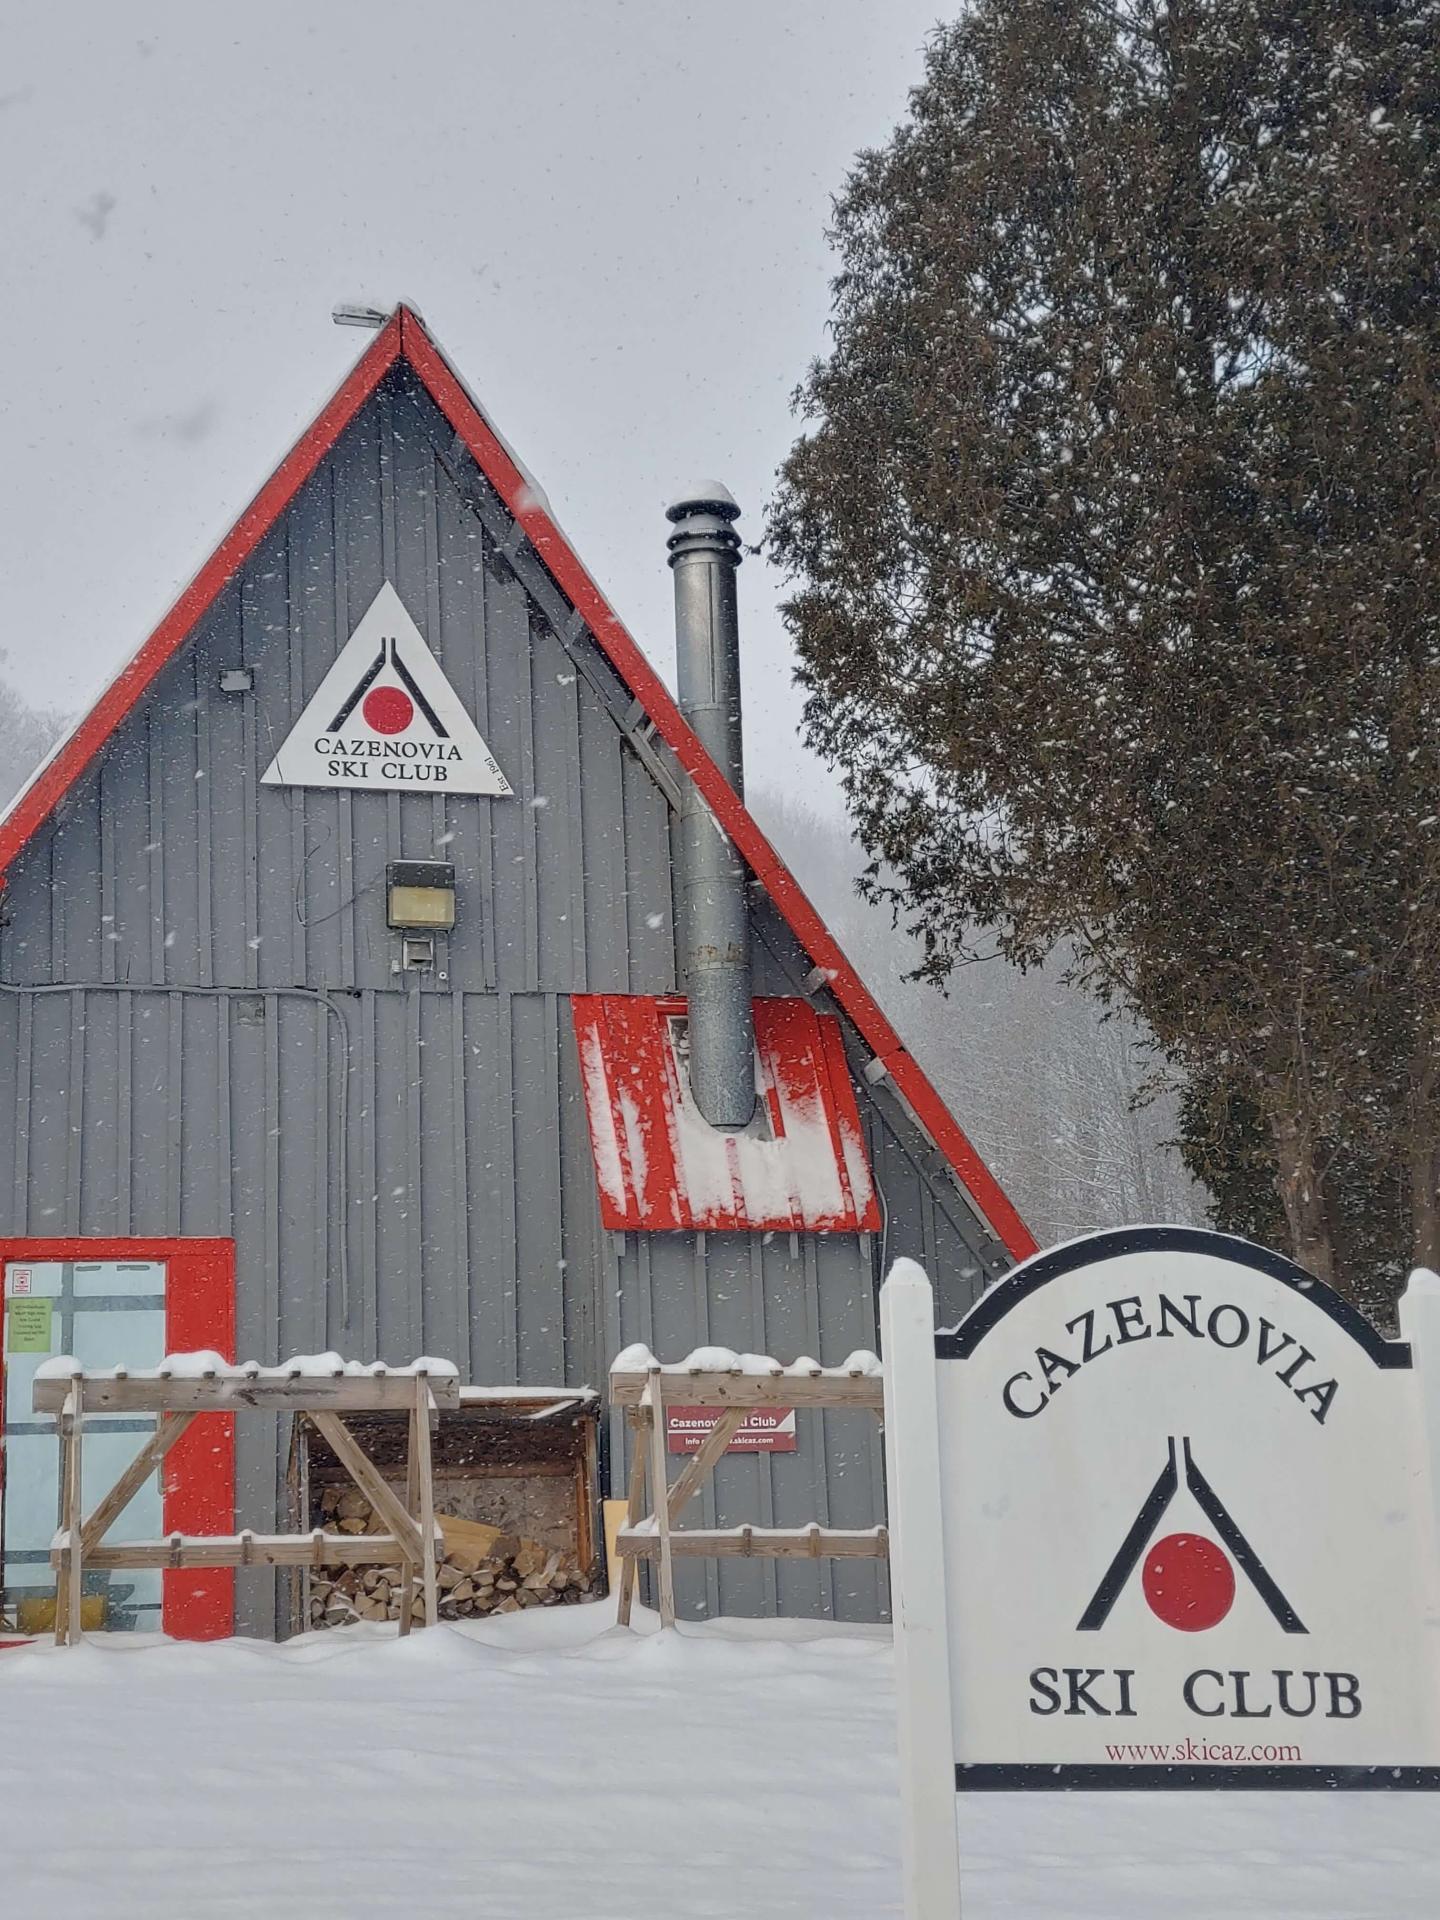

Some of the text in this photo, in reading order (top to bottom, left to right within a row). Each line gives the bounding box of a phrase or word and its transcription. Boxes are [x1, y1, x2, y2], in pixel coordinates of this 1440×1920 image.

[314, 737, 463, 761] CAZENOVIA
[328, 760, 448, 781] SKI CLUB
[484, 757, 509, 792] Est 1961
[1002, 1293, 1340, 1425] CAZENOVIA
[670, 1416, 720, 1428] Cazenov
[750, 1416, 776, 1427] Club
[685, 1437, 700, 1445] Info
[729, 1437, 774, 1445] .skicaz.com
[1028, 1667, 1363, 1719] SKI CLUB
[1105, 1738, 1303, 1762] www.skicaz.com
